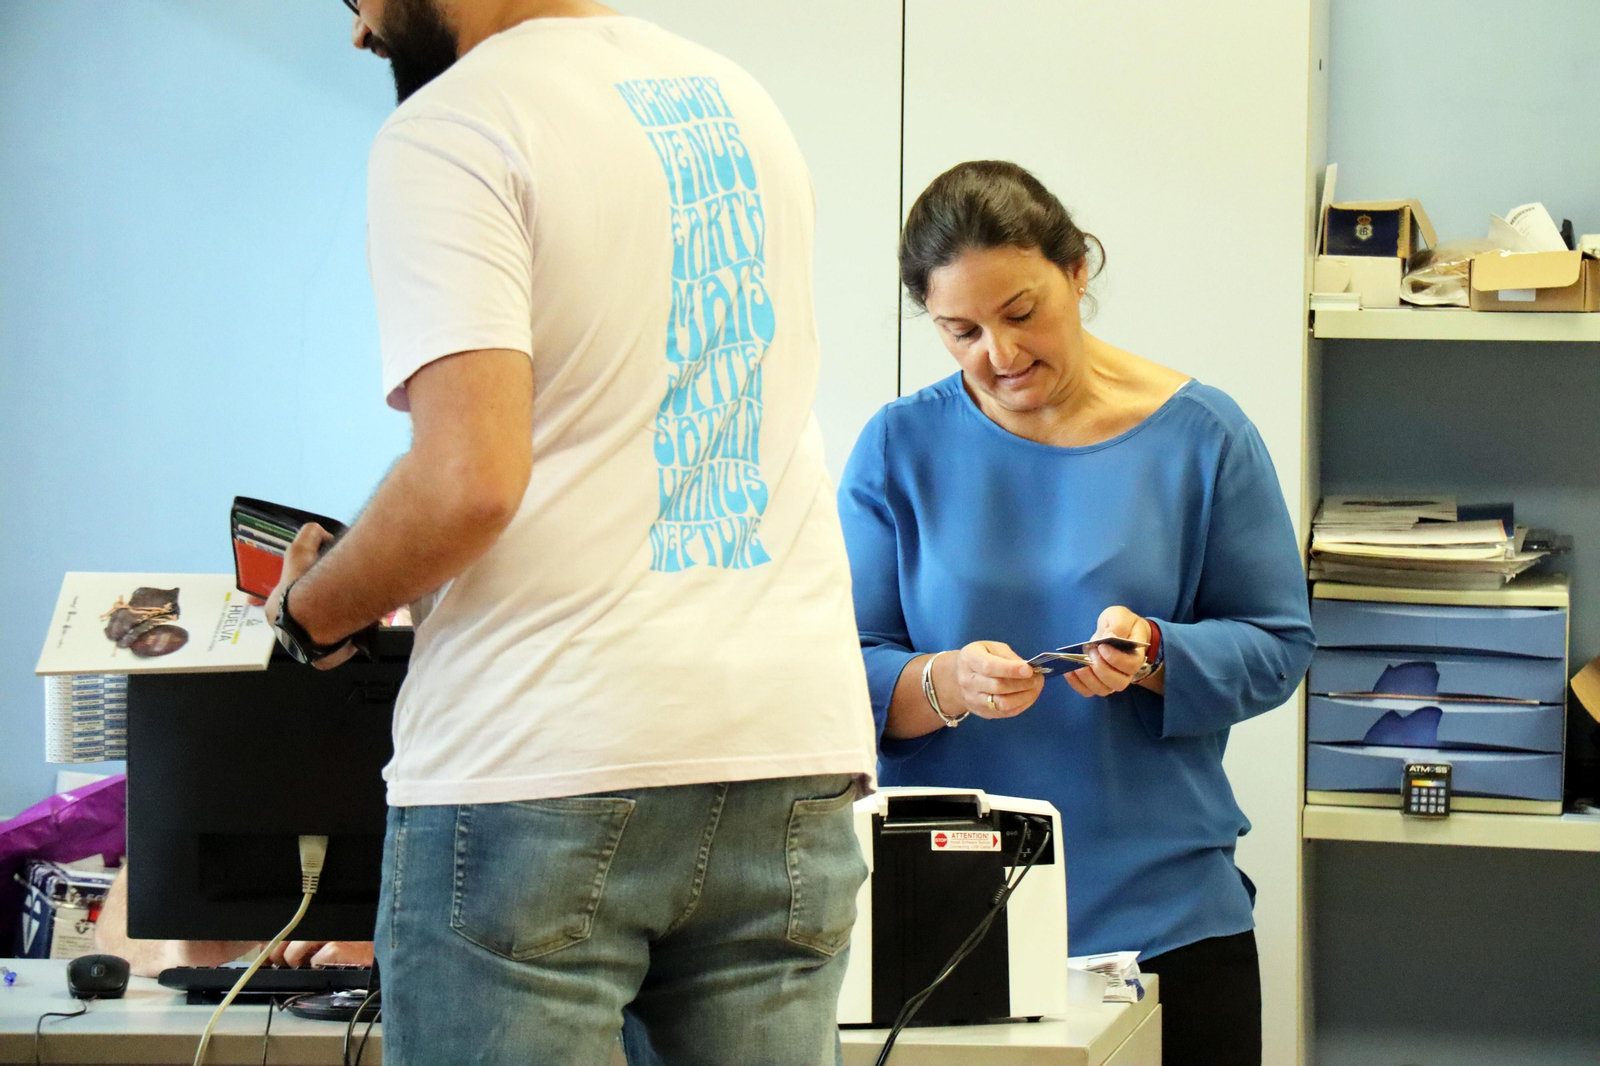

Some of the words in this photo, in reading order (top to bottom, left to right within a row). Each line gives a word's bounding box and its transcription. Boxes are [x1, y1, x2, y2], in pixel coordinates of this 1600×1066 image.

[614, 76, 735, 127] MERCURY
[645, 121, 758, 206] VENUS
[669, 191, 766, 281] EARTH
[666, 258, 776, 362] MARS
[654, 397, 763, 467] SATURN
[657, 461, 768, 522] URANUS
[650, 515, 772, 573] NEPTUNE
[218, 604, 243, 642] HUELVA
[1409, 765, 1447, 773] ATMOSS
